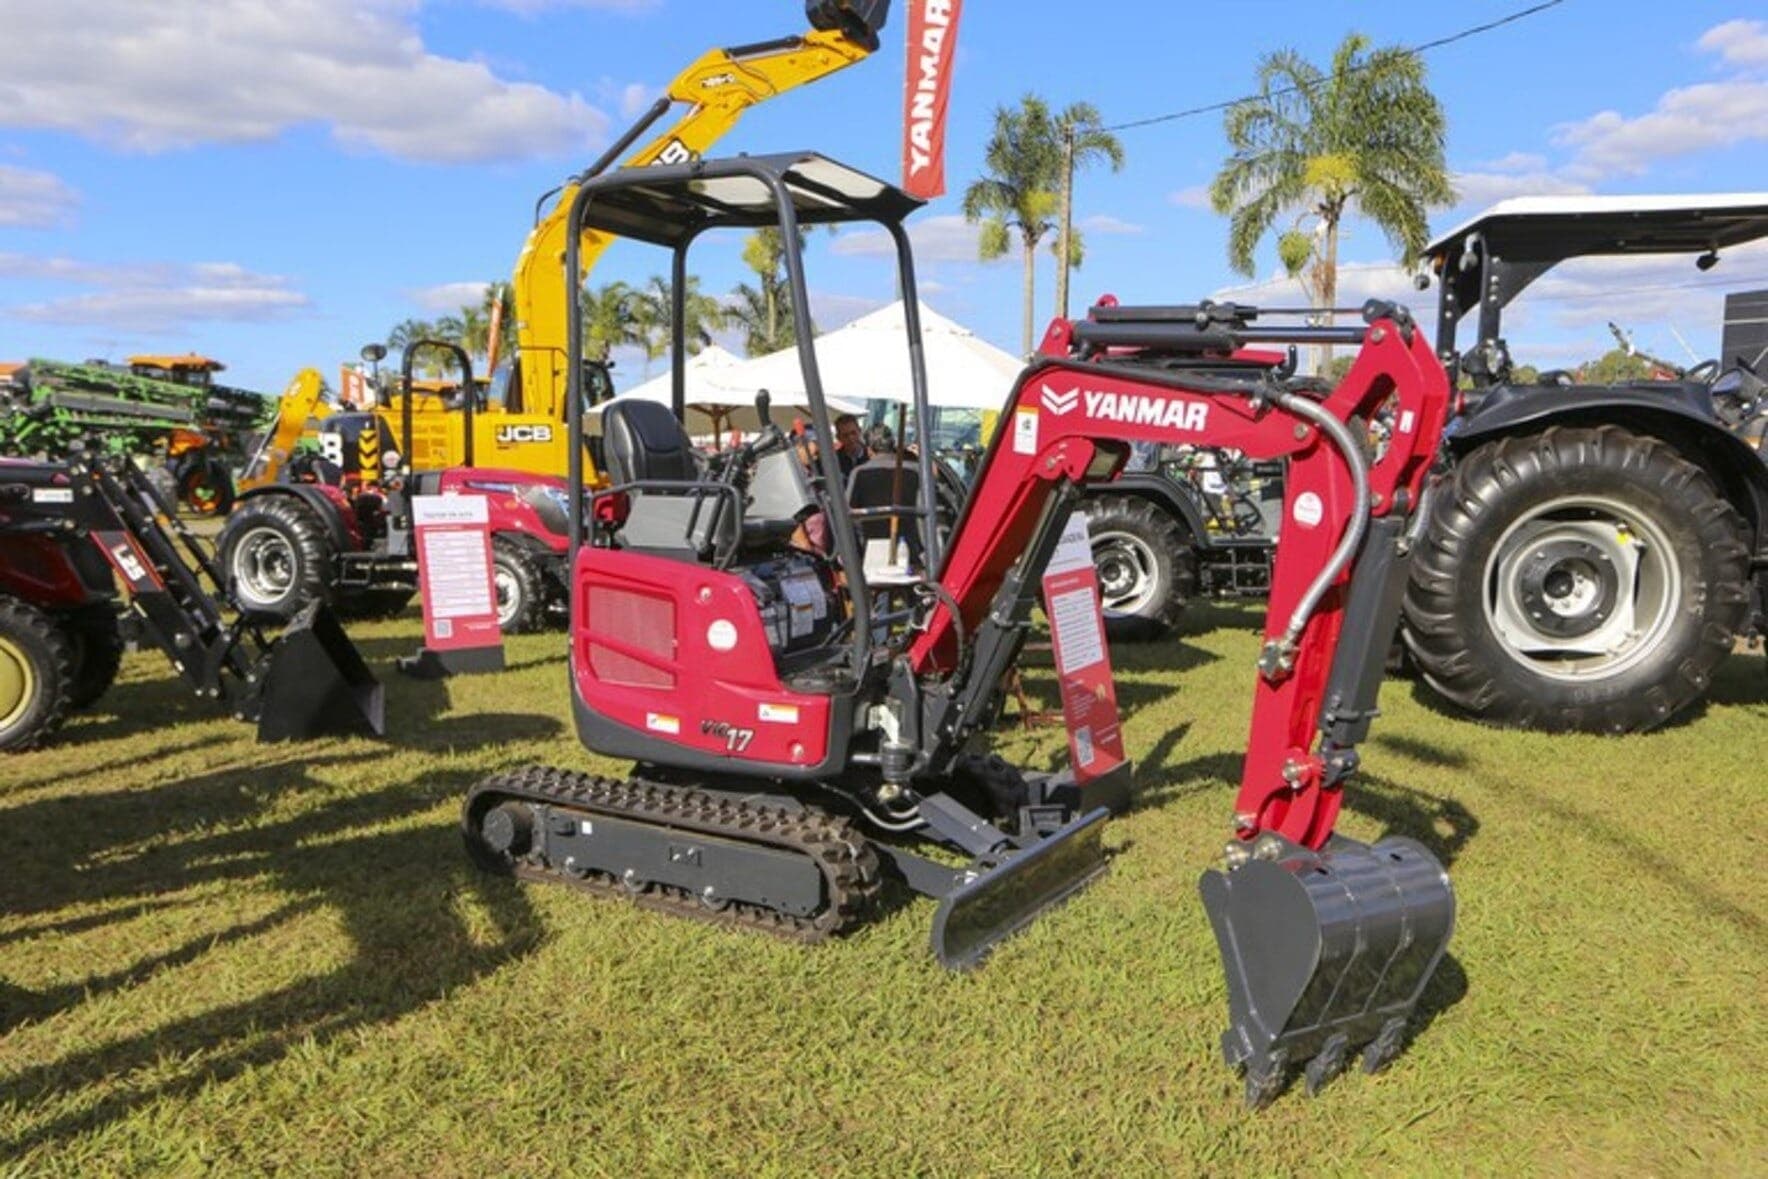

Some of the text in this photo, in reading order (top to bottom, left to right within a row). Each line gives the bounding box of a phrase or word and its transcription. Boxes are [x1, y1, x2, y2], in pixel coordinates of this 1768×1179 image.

[910, 0, 951, 177] YANMAR
[1084, 390, 1209, 432] YANMAR
[496, 424, 552, 442] JCB
